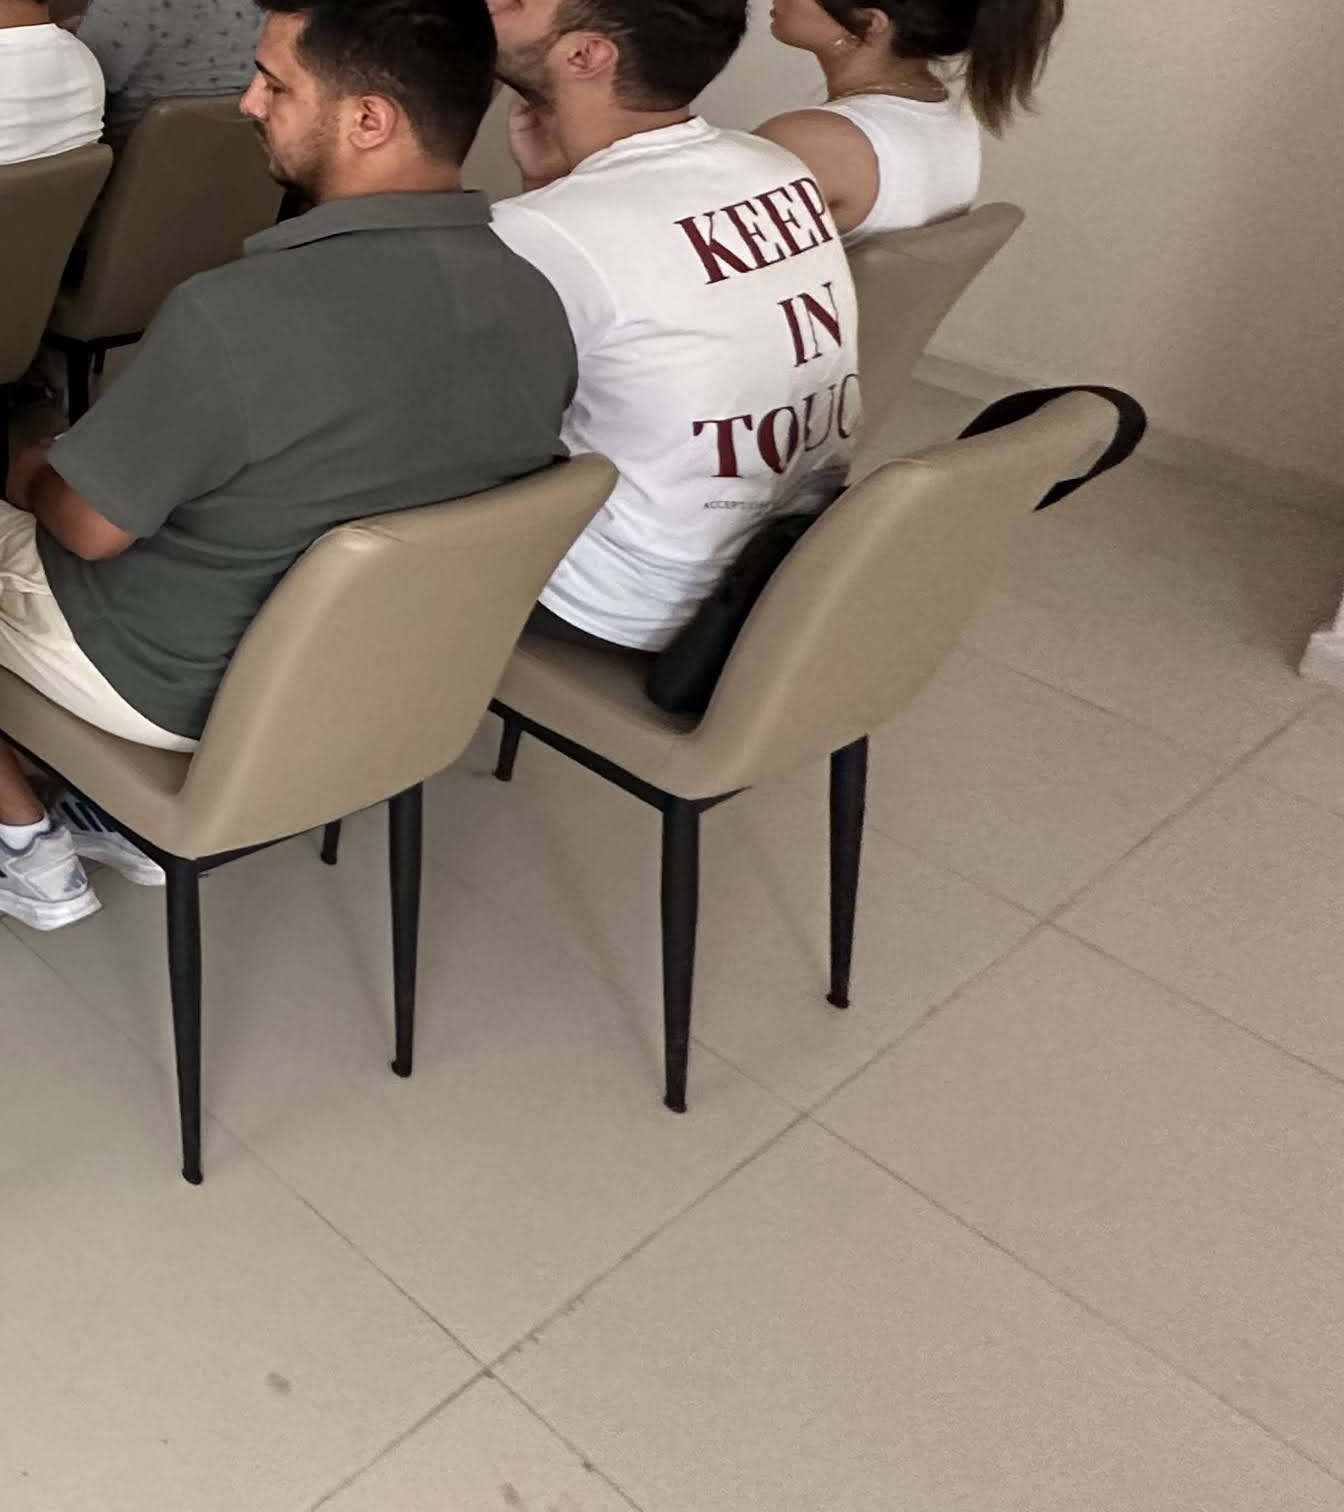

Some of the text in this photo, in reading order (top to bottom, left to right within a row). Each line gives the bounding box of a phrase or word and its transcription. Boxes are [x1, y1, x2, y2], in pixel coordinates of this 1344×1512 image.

[673, 177, 833, 285] KEEP
[777, 282, 842, 367] IN
[692, 373, 859, 478] TOUC
